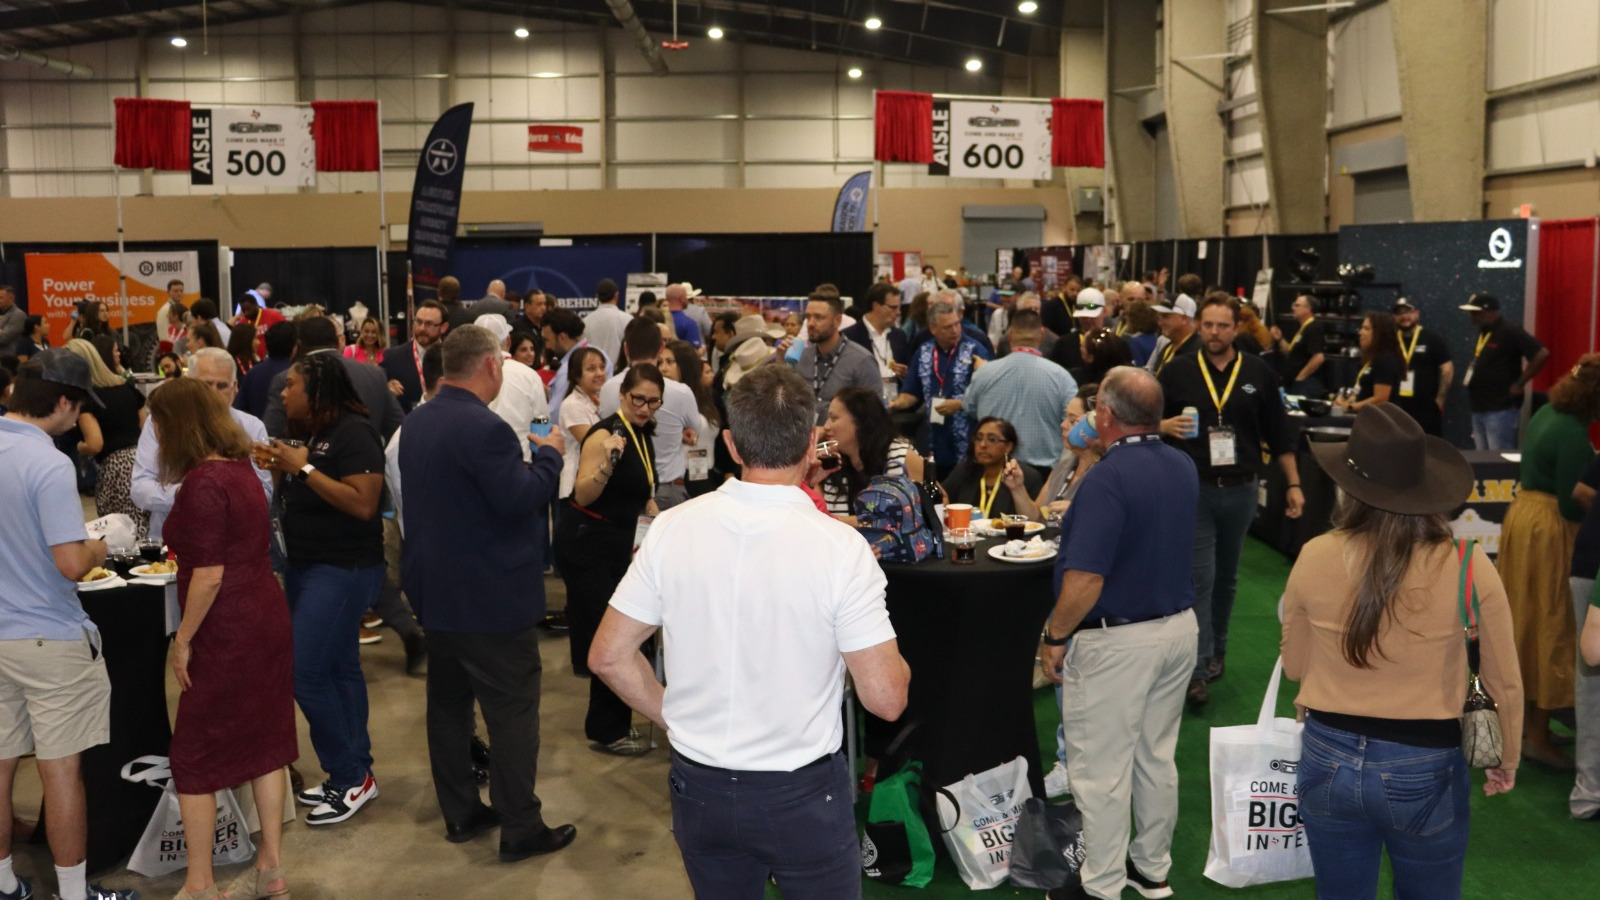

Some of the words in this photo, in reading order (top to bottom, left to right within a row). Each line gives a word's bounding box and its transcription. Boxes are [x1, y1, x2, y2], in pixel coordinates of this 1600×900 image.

[192, 116, 211, 175] AISLE
[932, 109, 949, 167] AISLE
[226, 149, 286, 176] 500
[963, 143, 1024, 169] 600
[156, 261, 184, 272] ROBOT
[43, 278, 95, 291] Power
[47, 310, 67, 318] with
[1250, 780, 1288, 794] COME
[1247, 834, 1269, 850] IN
[989, 850, 1003, 865] IN
